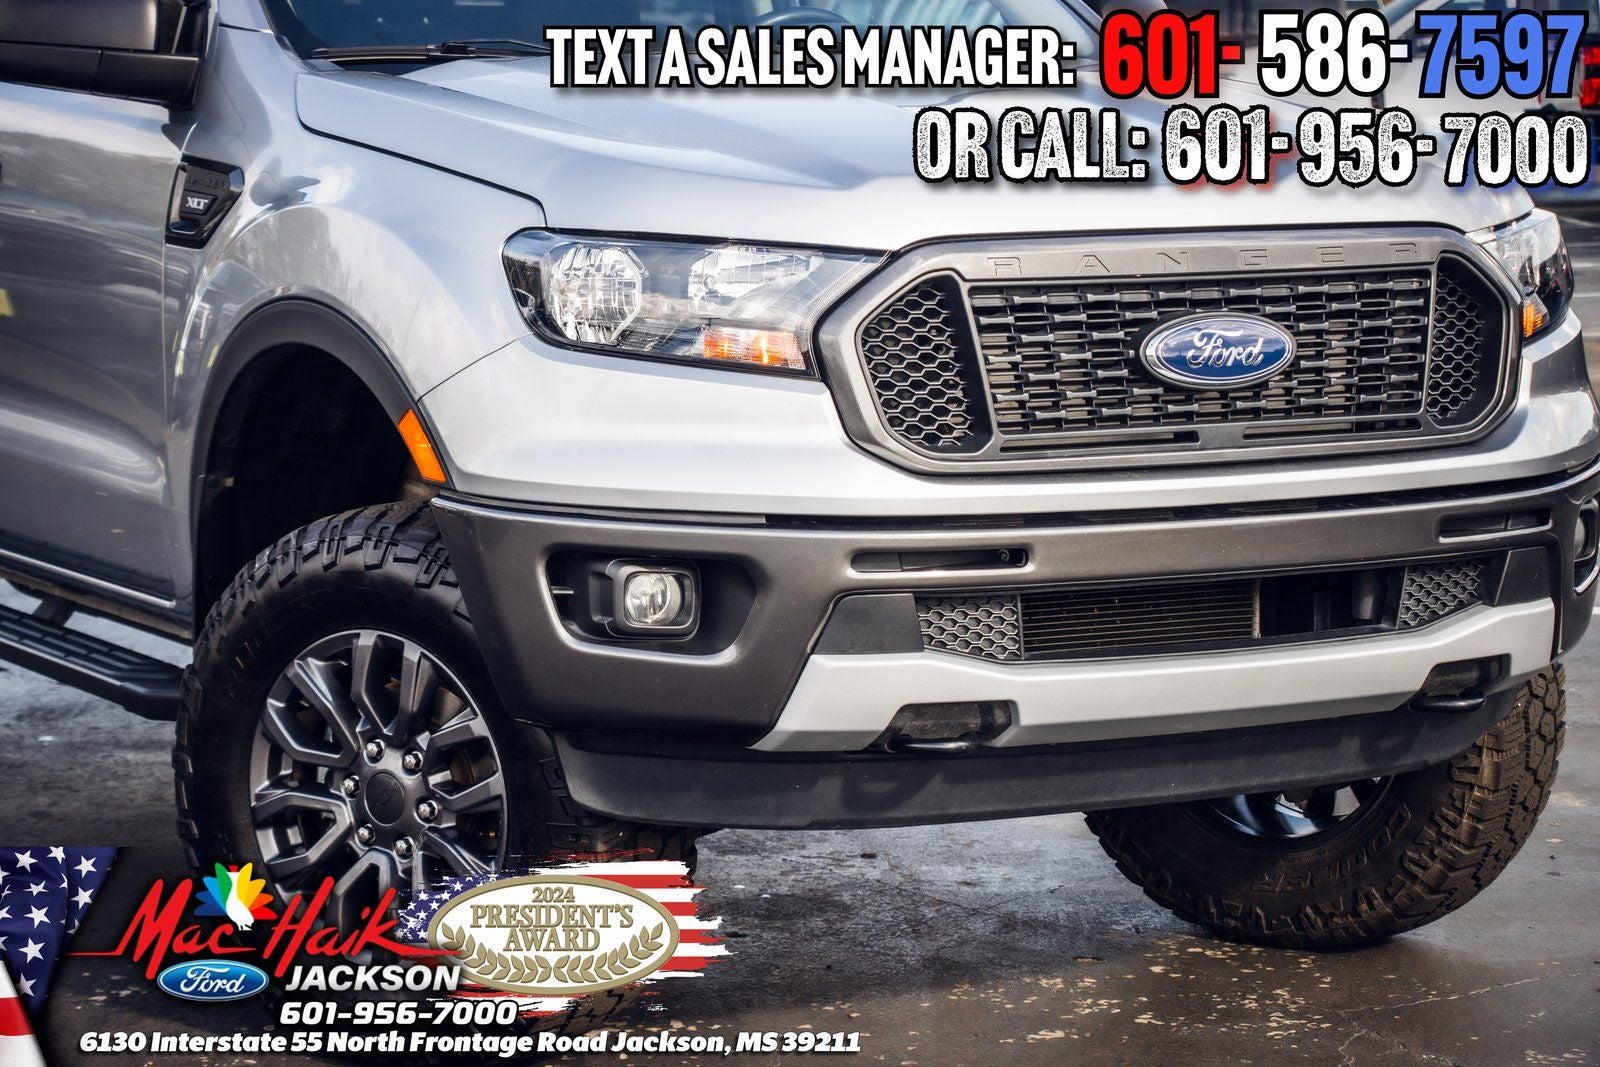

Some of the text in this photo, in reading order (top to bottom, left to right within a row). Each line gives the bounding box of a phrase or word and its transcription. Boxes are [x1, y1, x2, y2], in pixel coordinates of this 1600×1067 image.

[185, 196, 208, 210] XLT
[987, 243, 1418, 276] RANGER
[1186, 330, 1264, 367] Ford
